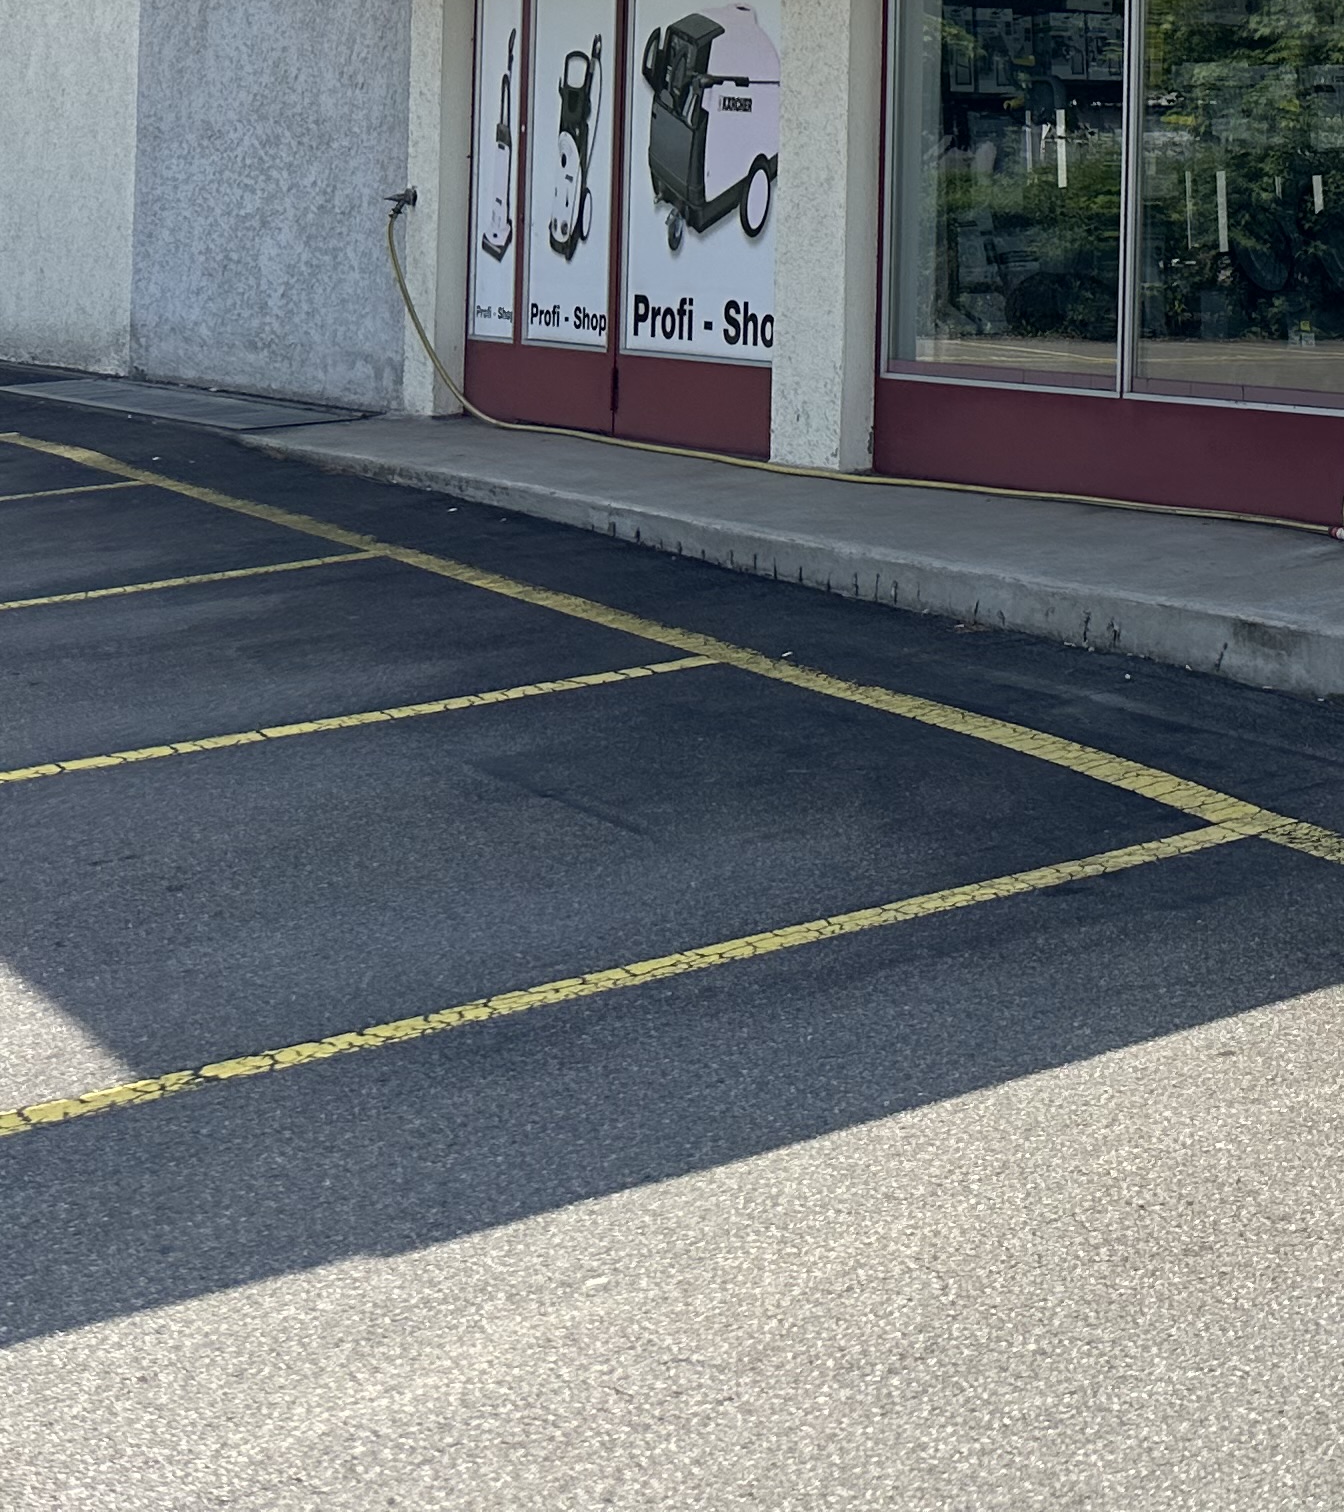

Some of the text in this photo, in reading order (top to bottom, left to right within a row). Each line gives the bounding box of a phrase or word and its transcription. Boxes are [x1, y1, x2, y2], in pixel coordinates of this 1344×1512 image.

[530, 302, 561, 328] Profi
[573, 306, 607, 336] Shop
[633, 294, 694, 341] Profi
[723, 300, 774, 348] Sho
